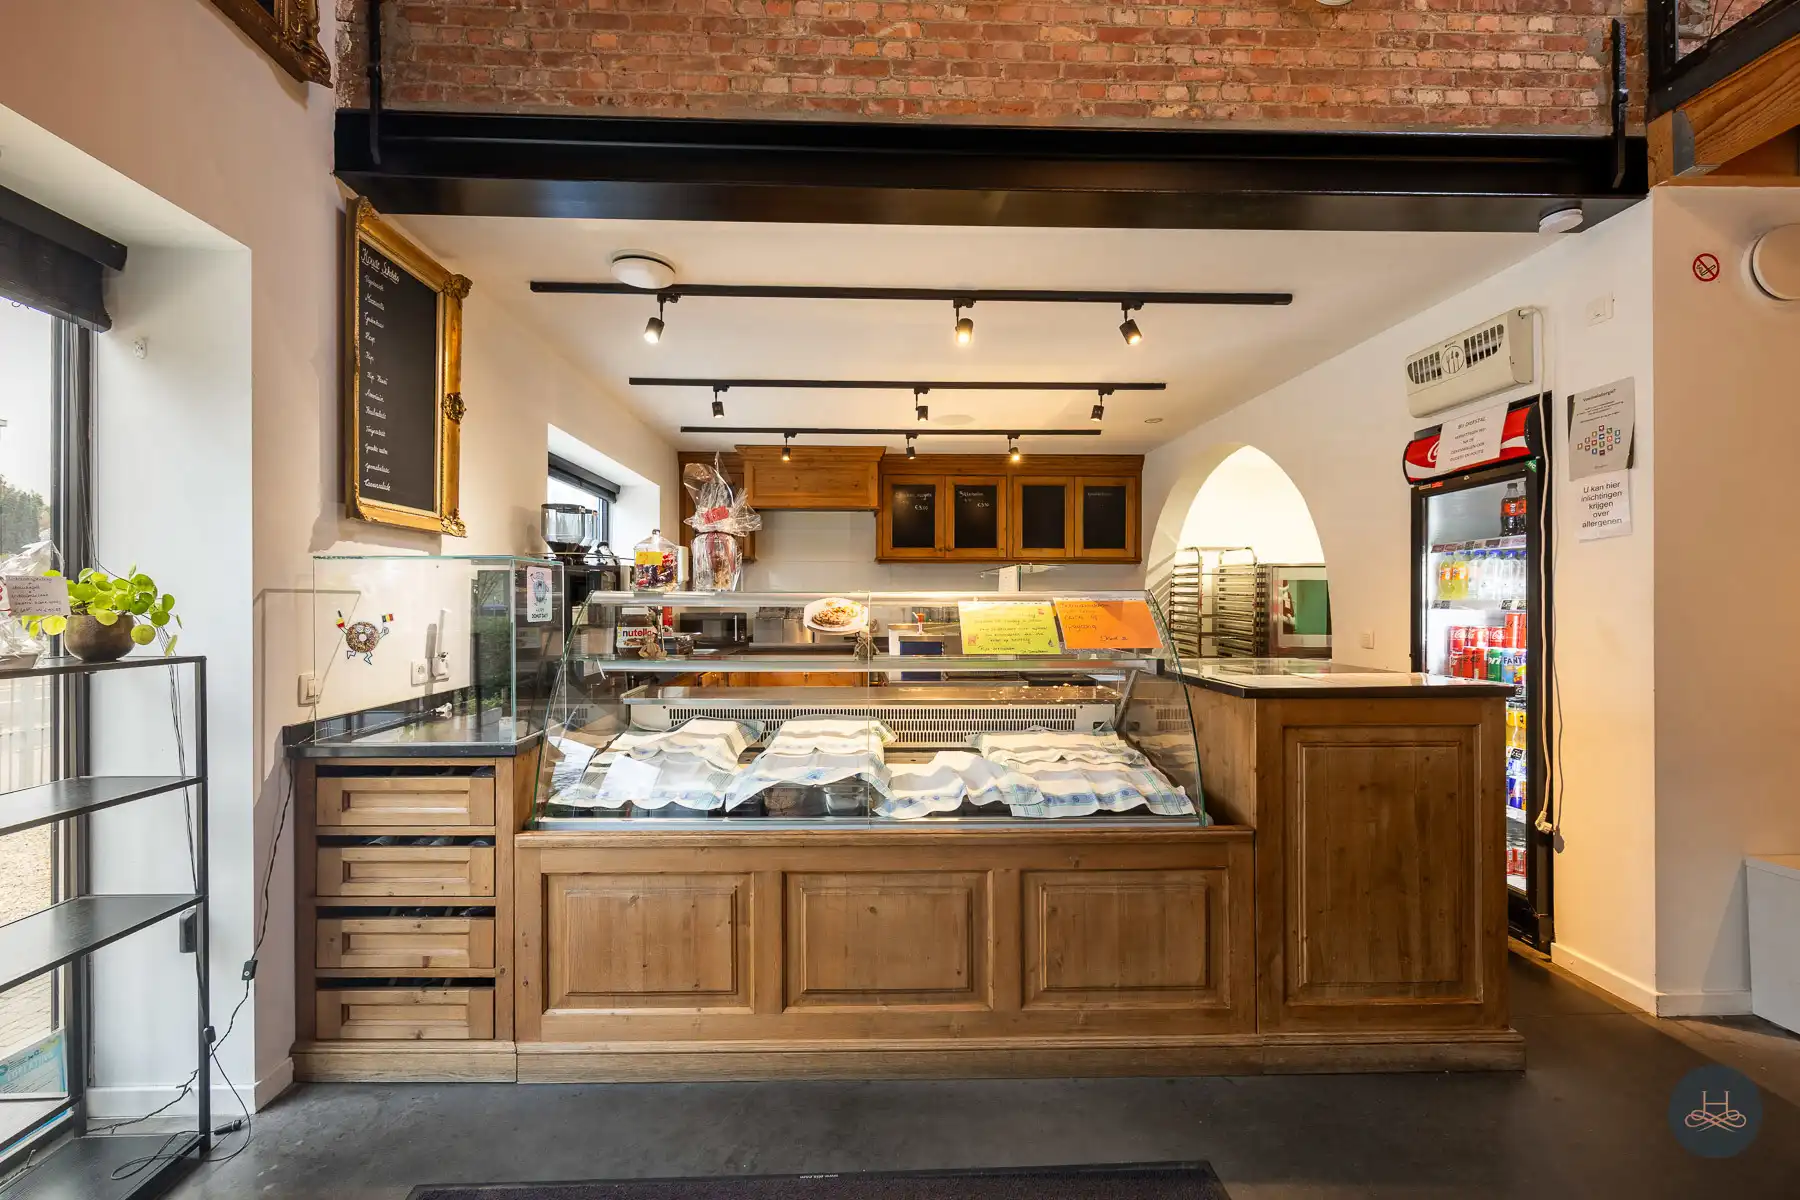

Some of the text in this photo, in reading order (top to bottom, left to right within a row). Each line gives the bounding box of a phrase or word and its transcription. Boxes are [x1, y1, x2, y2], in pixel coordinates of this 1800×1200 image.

[1591, 484, 1604, 492] kan
[1605, 481, 1621, 489] hier
[1581, 490, 1622, 502] inlichtingen
[1588, 501, 1614, 510] krijgen
[1592, 510, 1610, 518] over
[1582, 518, 1622, 528] allergenen
